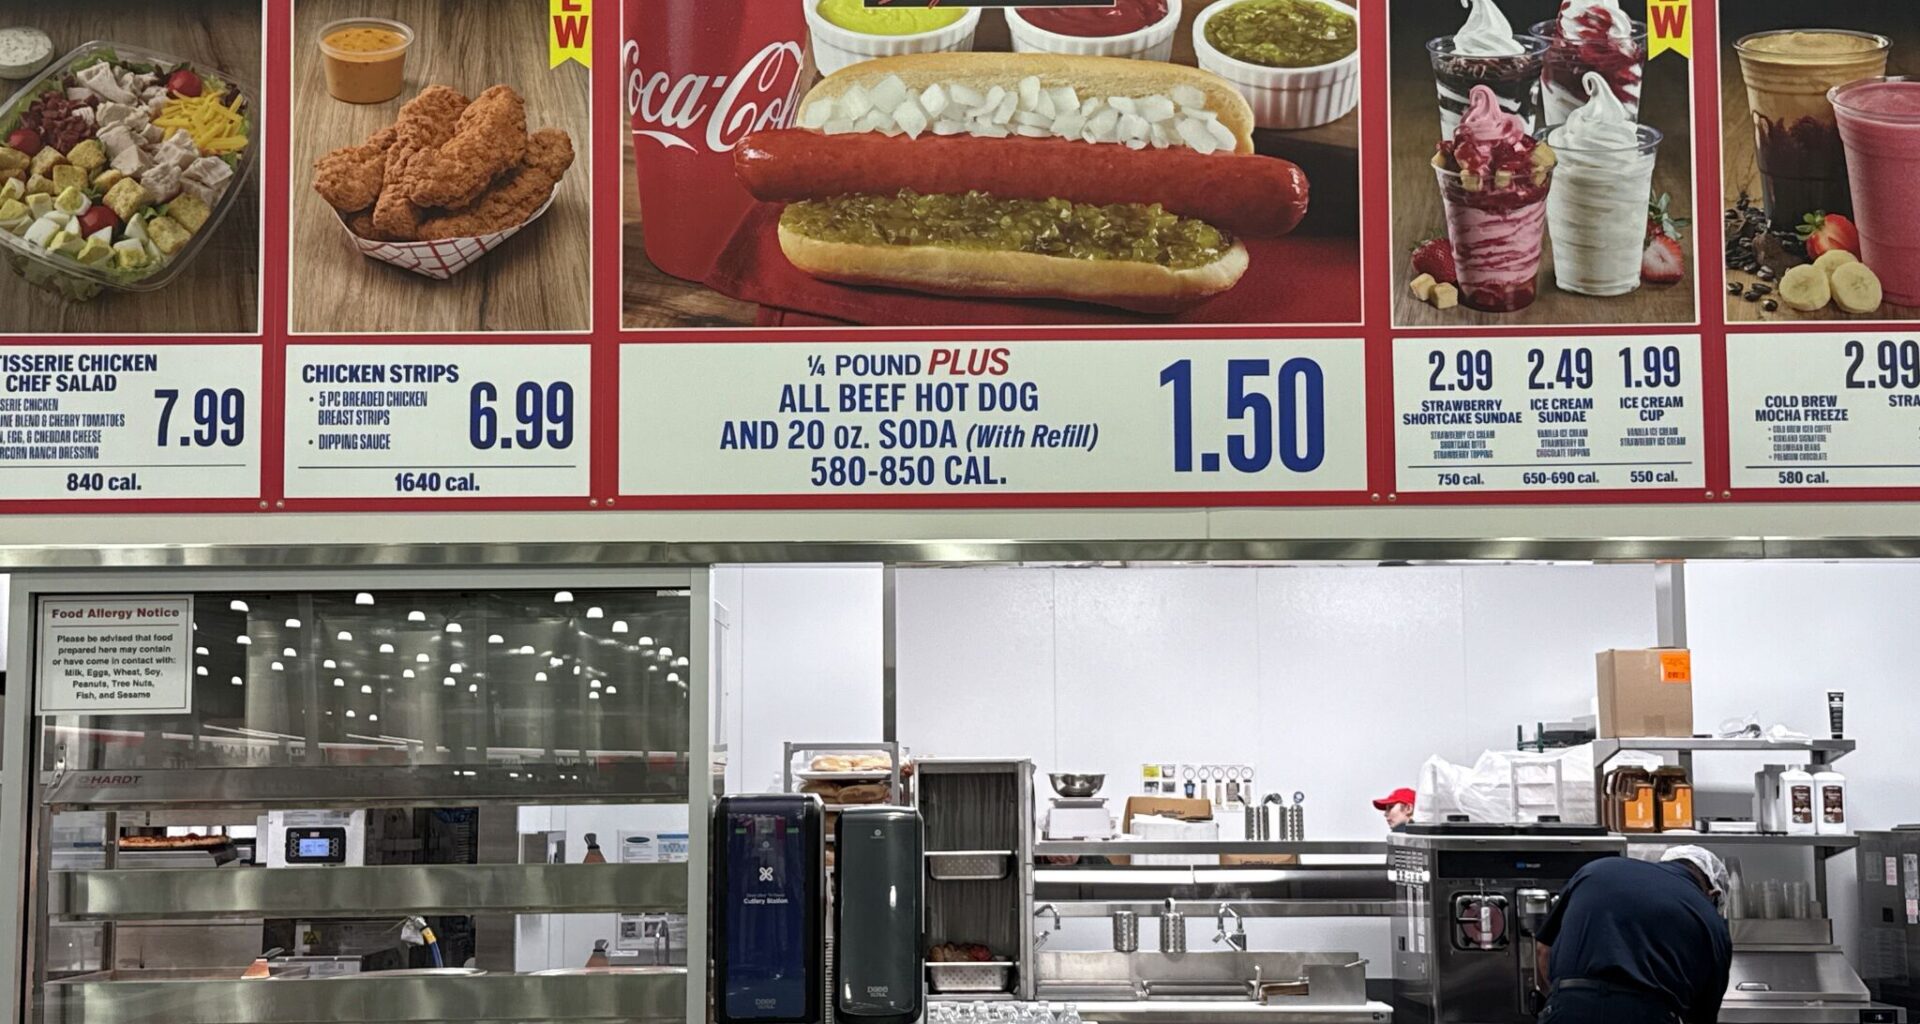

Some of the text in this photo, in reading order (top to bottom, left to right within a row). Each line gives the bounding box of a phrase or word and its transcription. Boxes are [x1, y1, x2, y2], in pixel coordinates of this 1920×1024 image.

[0, 354, 157, 372] ISSERIE CHICKEN
[836, 354, 921, 376] POUND
[928, 348, 1010, 376] PLUS
[1528, 348, 1593, 389] 2.49
[1619, 346, 1680, 388] 1.99
[1845, 340, 1920, 389] 2.99
[303, 364, 459, 383] CHICKEN STRIPS
[1429, 350, 1492, 391] 2.99
[6, 374, 117, 392] CHEF SALAD
[319, 391, 427, 407] 5 PC BREADED CHICKEN
[779, 382, 1038, 412] ALL BEEF HOT DOG
[1620, 397, 1683, 409] ICE CREAM
[1765, 396, 1837, 407] COLD BREW
[23, 398, 58, 411] CHICKEN
[1422, 400, 1502, 412] STRAWBERRY
[1530, 398, 1593, 411] ICE CREAM
[15, 414, 40, 427] BLEND
[42, 414, 47, 427] &
[49, 414, 80, 427] CHERRY
[82, 414, 125, 427] TOMATOES
[155, 388, 244, 447] 7.99
[318, 410, 390, 425] BREAST STRIPS
[470, 381, 573, 450] 6.99
[1160, 357, 1325, 473] 1.50
[1403, 412, 1522, 425] SHORTCAKE SUNDAE
[1539, 411, 1586, 423] SUNDAE
[1640, 409, 1664, 421] CUP
[1756, 409, 1848, 421] MOCHA FREEZE
[27, 430, 32, 443] &
[34, 430, 71, 443] CHEDDAR
[73, 430, 101, 443] CHEESE
[319, 434, 390, 449] DIPPING SAUCE
[720, 419, 1098, 452] AND 20 oz. SODA (With Refill)
[29, 446, 57, 459] RANCH
[59, 446, 99, 459] DRESSING
[811, 455, 1006, 486] 580-850 CAL.
[1630, 471, 1678, 483] 550 cal.
[1779, 471, 1829, 483] 580 cal.
[67, 473, 141, 491] 840 cal.
[395, 473, 479, 491] 1640 cal.
[1438, 474, 1484, 485] 750 cal.
[1523, 472, 1599, 484] 650-690 cal.
[52, 607, 179, 620] Food Allergy Notice
[57, 633, 173, 643] Please be advised that food
[58, 645, 171, 656] prepared here may contain
[64, 658, 84, 666] have
[111, 657, 119, 665] in
[122, 657, 153, 665] contact
[73, 679, 155, 689] Peanuts, Tree Nuts,
[76, 691, 151, 701] Fish, and Sesame
[91, 775, 142, 785] HARDT
